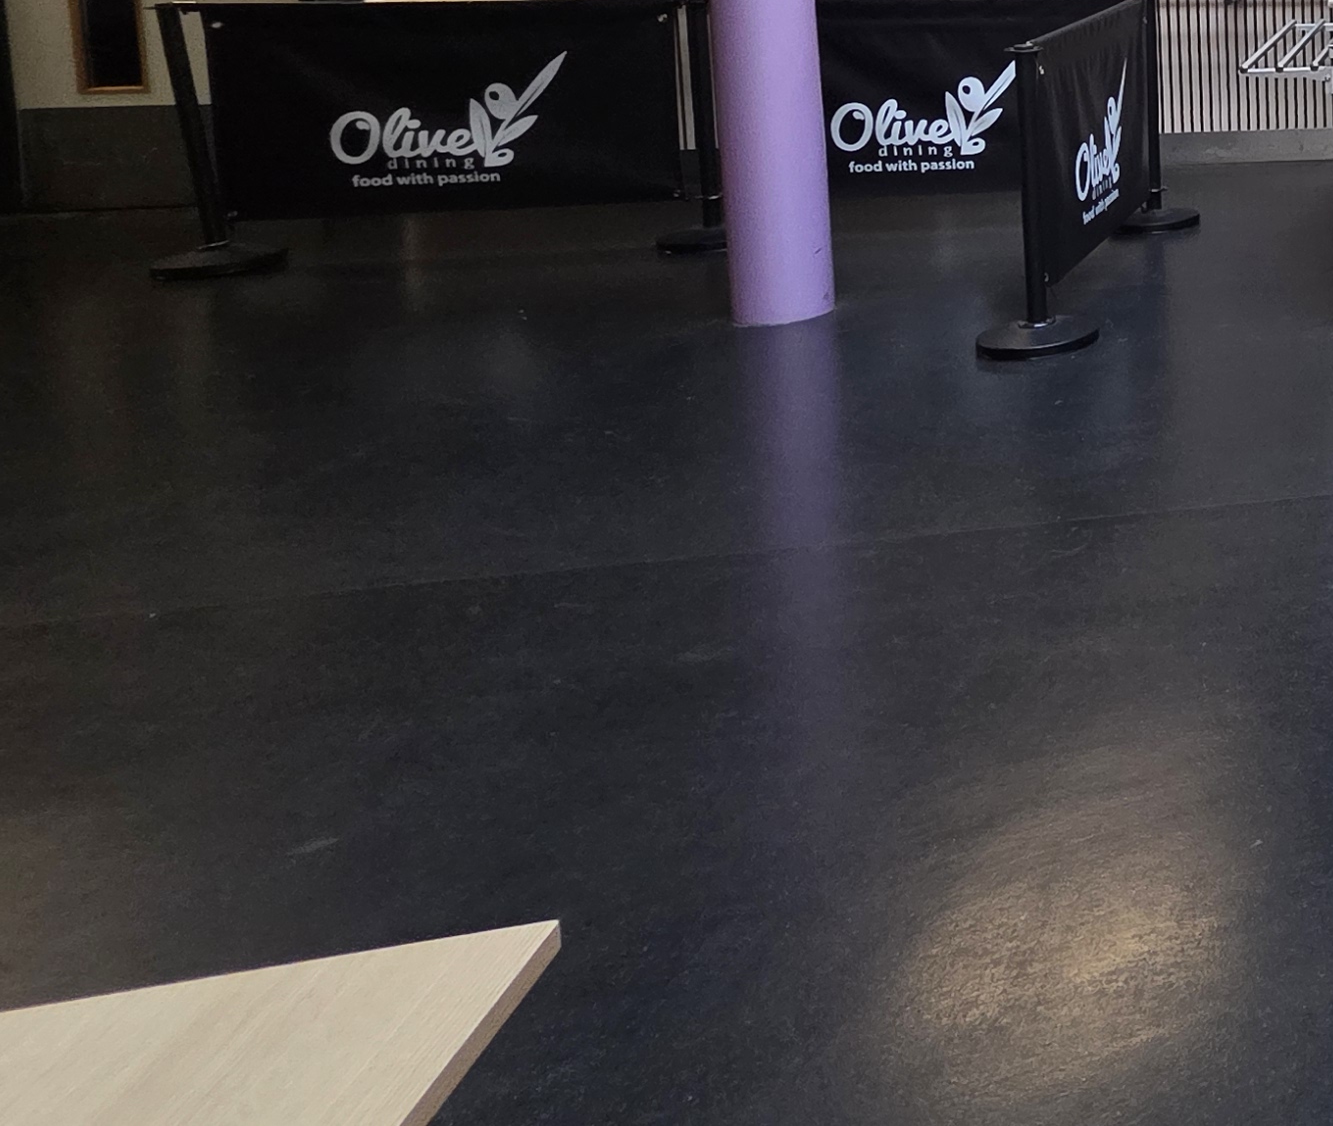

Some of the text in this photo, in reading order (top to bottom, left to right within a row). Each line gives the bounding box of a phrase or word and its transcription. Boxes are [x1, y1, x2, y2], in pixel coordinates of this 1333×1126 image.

[830, 98, 955, 152] Olive
[330, 106, 478, 165] Olive
[878, 144, 953, 158] dining
[387, 157, 475, 170] dining
[849, 158, 975, 173] food with passion
[1075, 133, 1110, 202] Olive
[352, 171, 501, 187] food with passion
